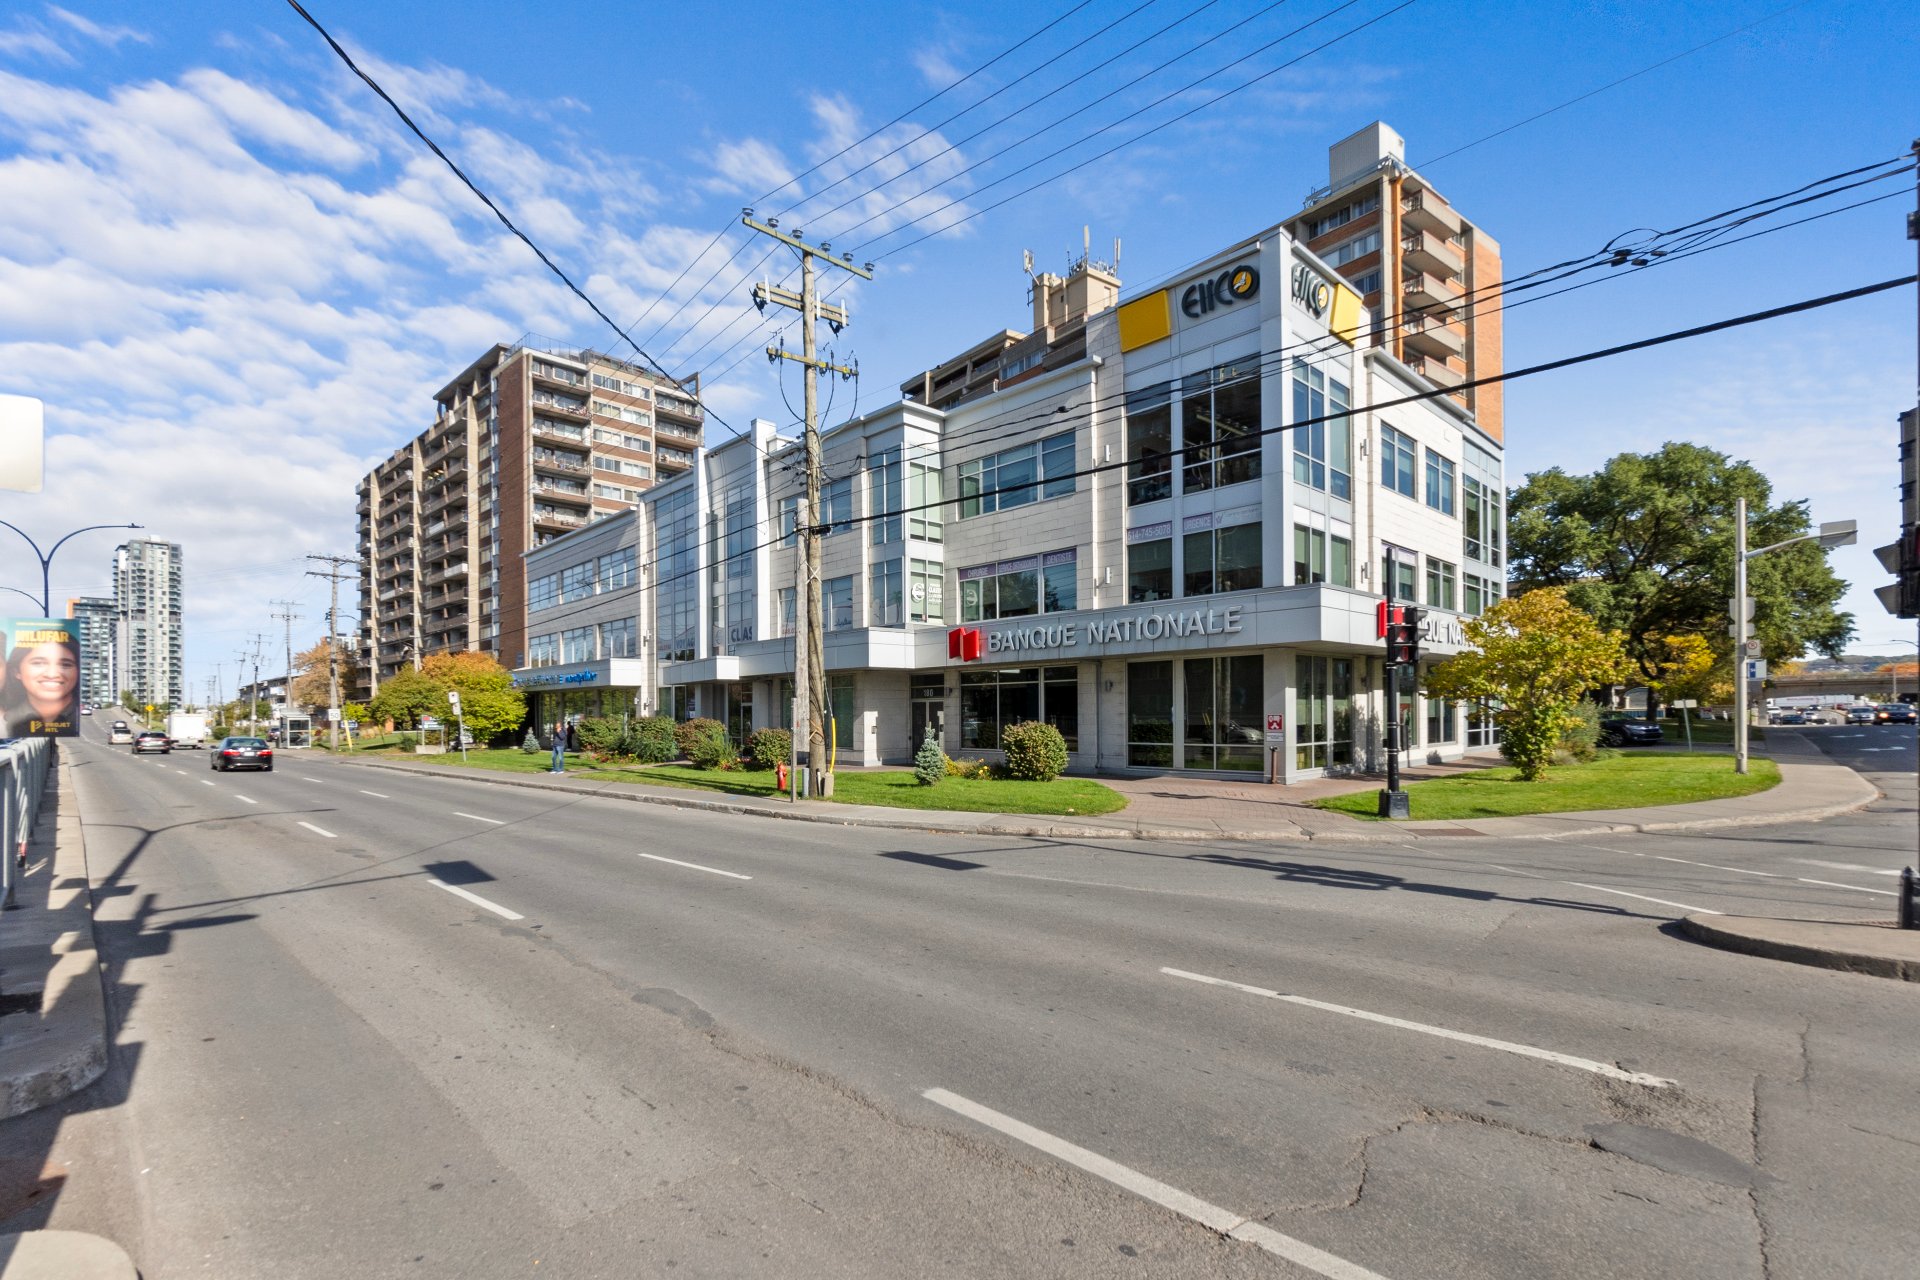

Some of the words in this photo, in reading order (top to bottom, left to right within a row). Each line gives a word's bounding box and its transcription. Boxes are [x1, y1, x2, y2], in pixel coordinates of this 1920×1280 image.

[1047, 551, 1073, 565] DENTISTE
[988, 623, 1077, 653] BANQUE
[1087, 605, 1243, 645] NATIONALE
